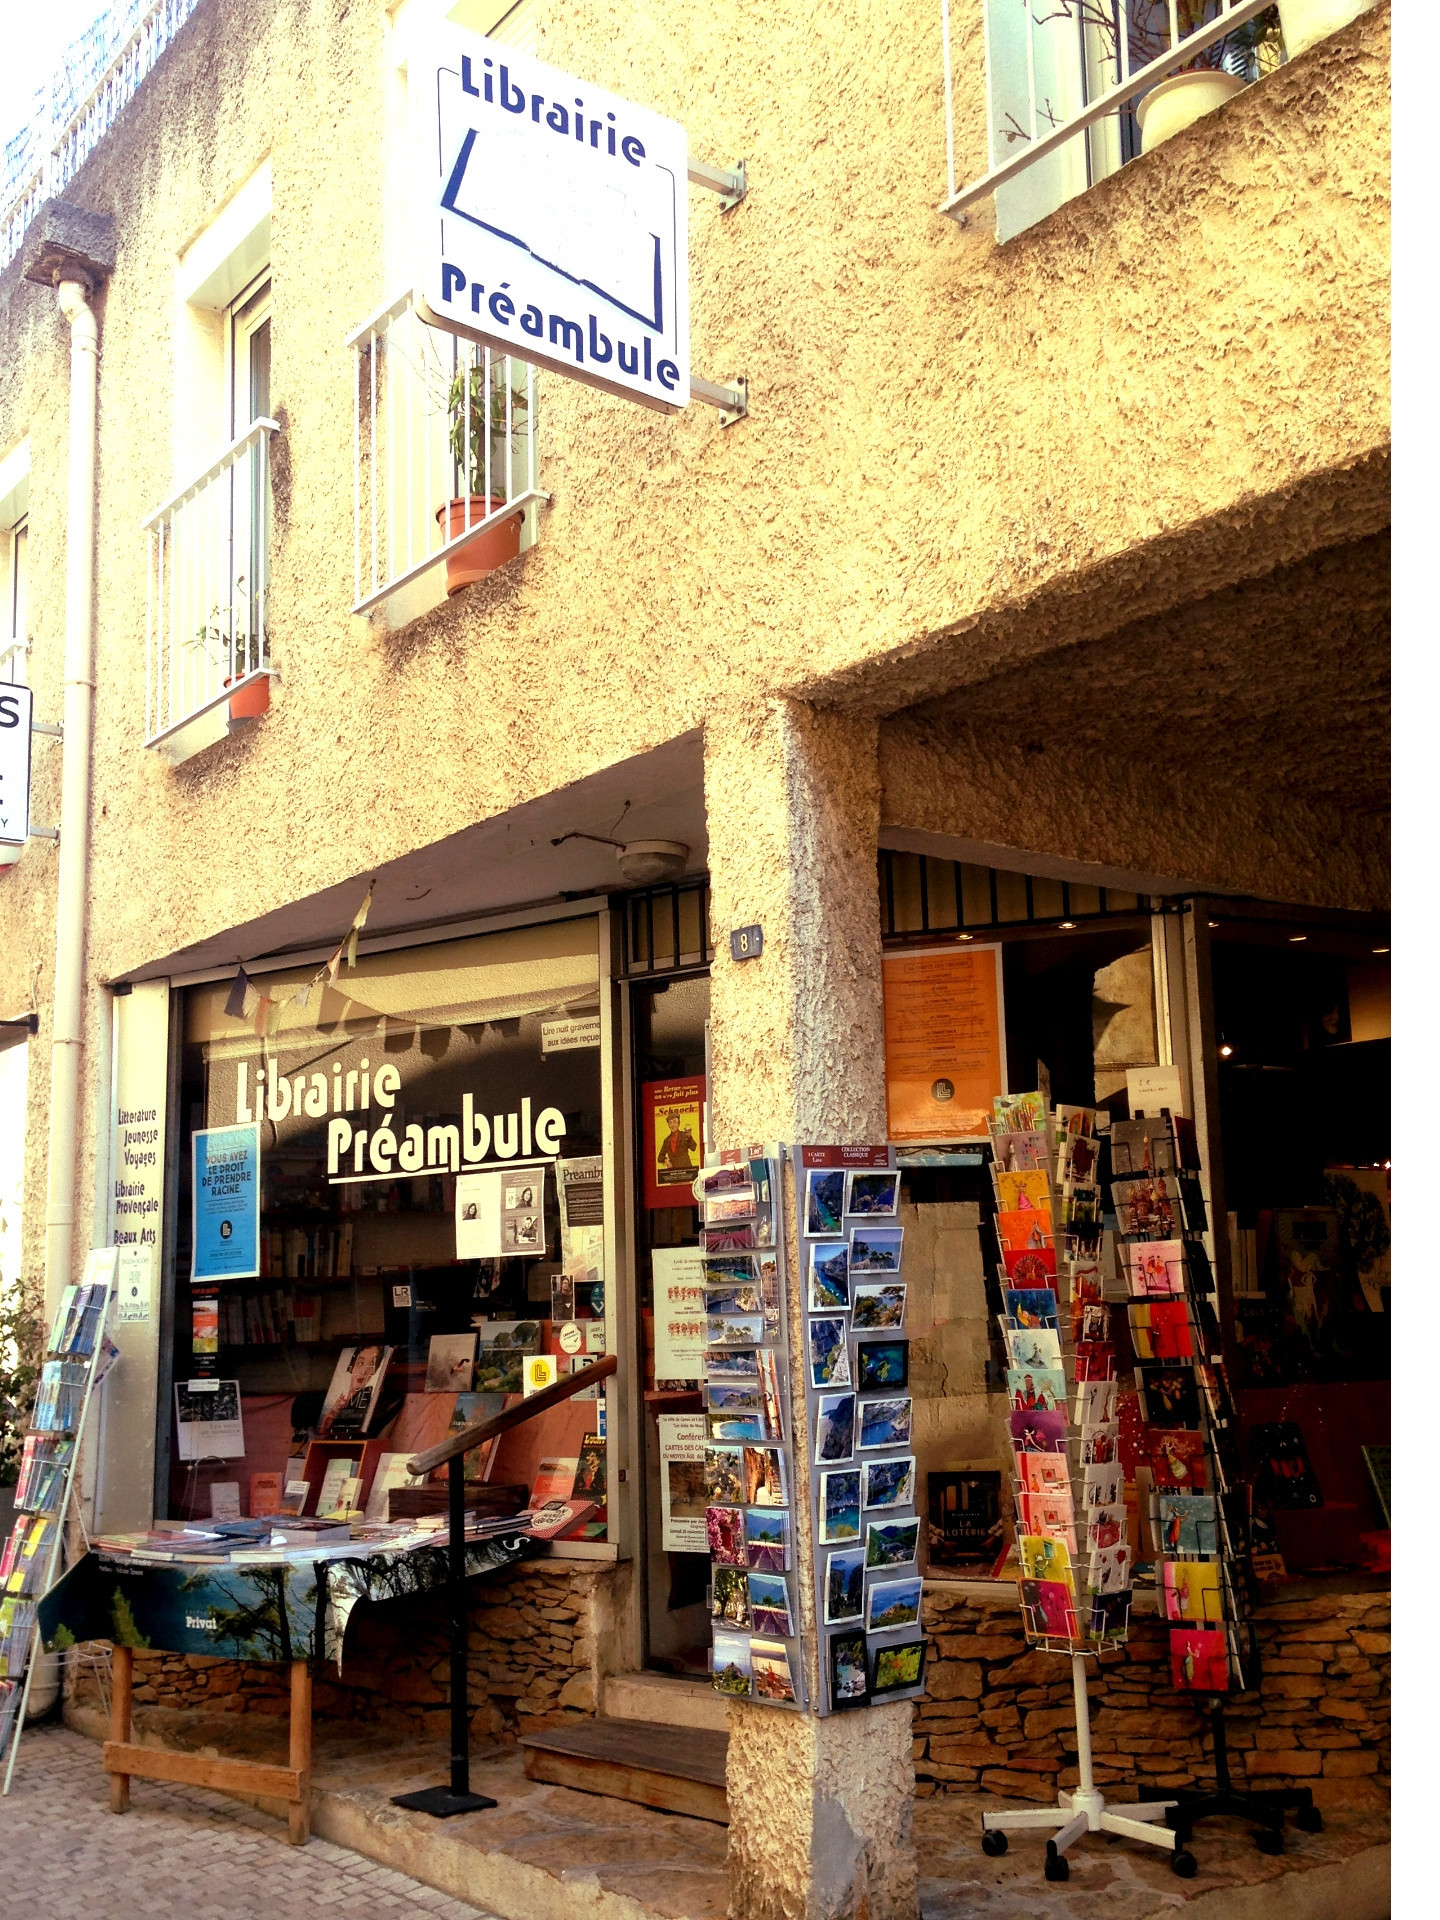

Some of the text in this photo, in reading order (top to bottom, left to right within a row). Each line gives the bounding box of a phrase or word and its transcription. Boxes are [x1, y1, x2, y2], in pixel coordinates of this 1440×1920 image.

[462, 55, 646, 167] Librairie
[442, 262, 680, 391] Préambule
[740, 933, 748, 952] 8
[543, 1027, 556, 1036] Lire
[556, 1025, 569, 1034] nuit
[547, 1039, 559, 1047] aux
[560, 1036, 578, 1045] idées
[236, 1058, 401, 1123] Librairie
[673, 1090, 685, 1099] fait
[685, 1089, 699, 1098] plus
[658, 1104, 695, 1115] Schnock
[124, 1129, 158, 1147] Jeunesse
[327, 1093, 566, 1174] Préambule
[124, 1149, 156, 1169] Voyages
[229, 1151, 248, 1161] AVEZ
[208, 1162, 245, 1175] LE DROIT
[202, 1171, 251, 1187] DE PRENDRE
[115, 1180, 145, 1198] Librairie
[116, 1198, 158, 1219] Provençale
[114, 1228, 156, 1244] Beaux Arts
[959, 1520, 972, 1528] LA
[946, 1528, 985, 1537] LOTERIE
[185, 1616, 218, 1630] Privat
